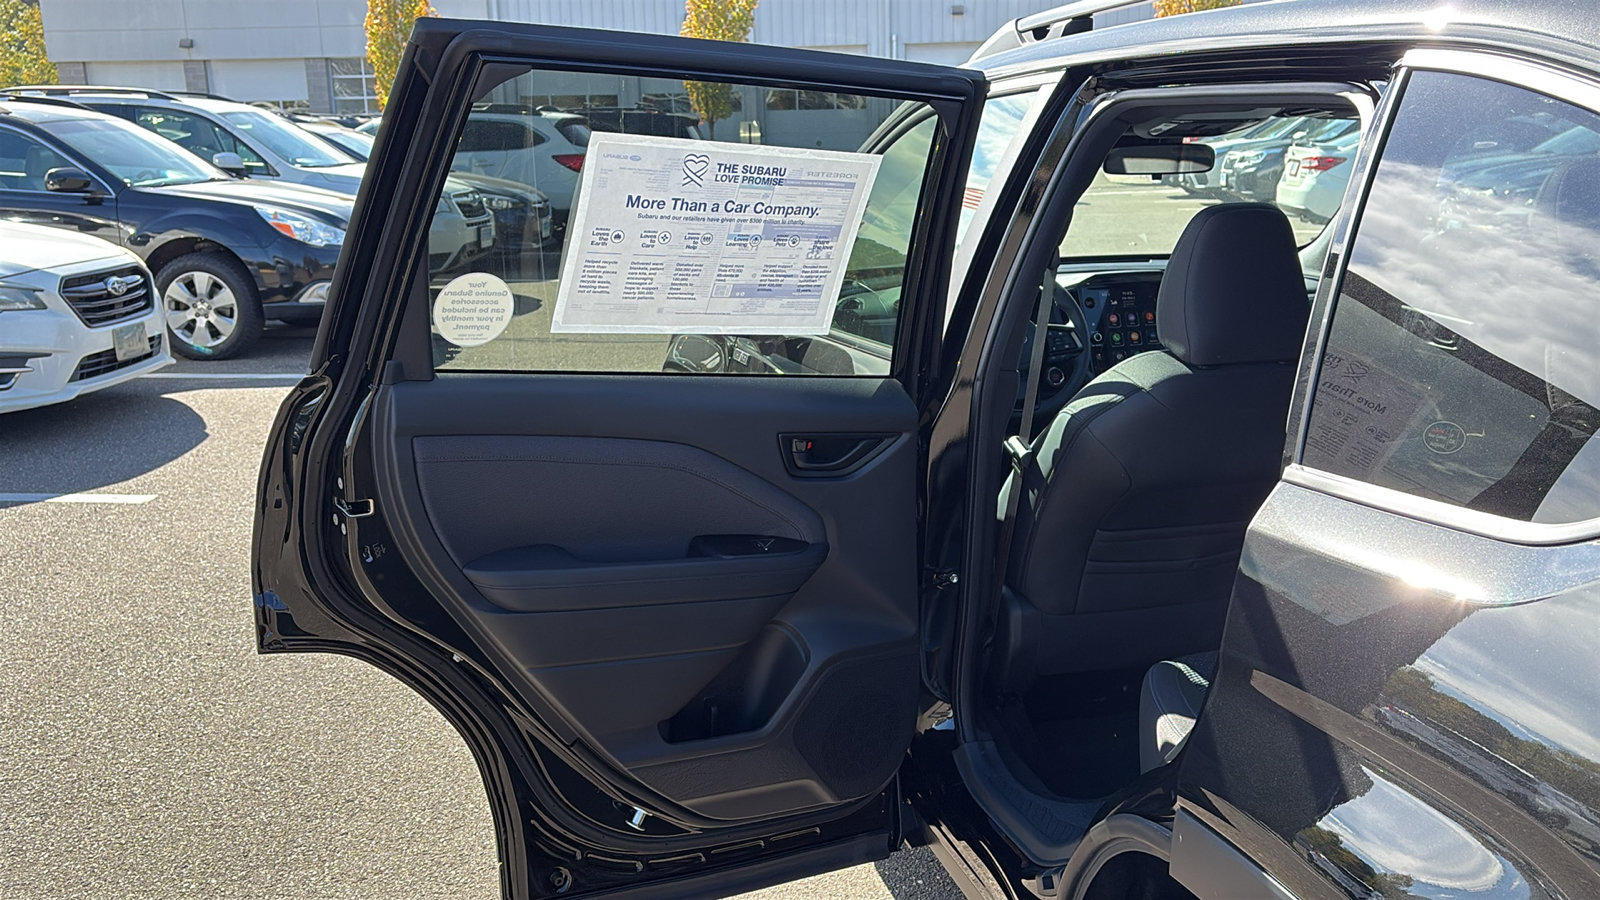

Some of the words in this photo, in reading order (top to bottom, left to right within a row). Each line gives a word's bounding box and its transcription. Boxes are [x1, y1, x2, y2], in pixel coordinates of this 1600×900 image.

[717, 163, 739, 173] THE
[741, 165, 787, 177] SUBARU
[715, 174, 739, 183] LOVE
[741, 176, 785, 186] PROMISE
[626, 195, 666, 209] More
[672, 197, 707, 212] Than
[711, 203, 720, 212] a
[724, 200, 750, 213] Car
